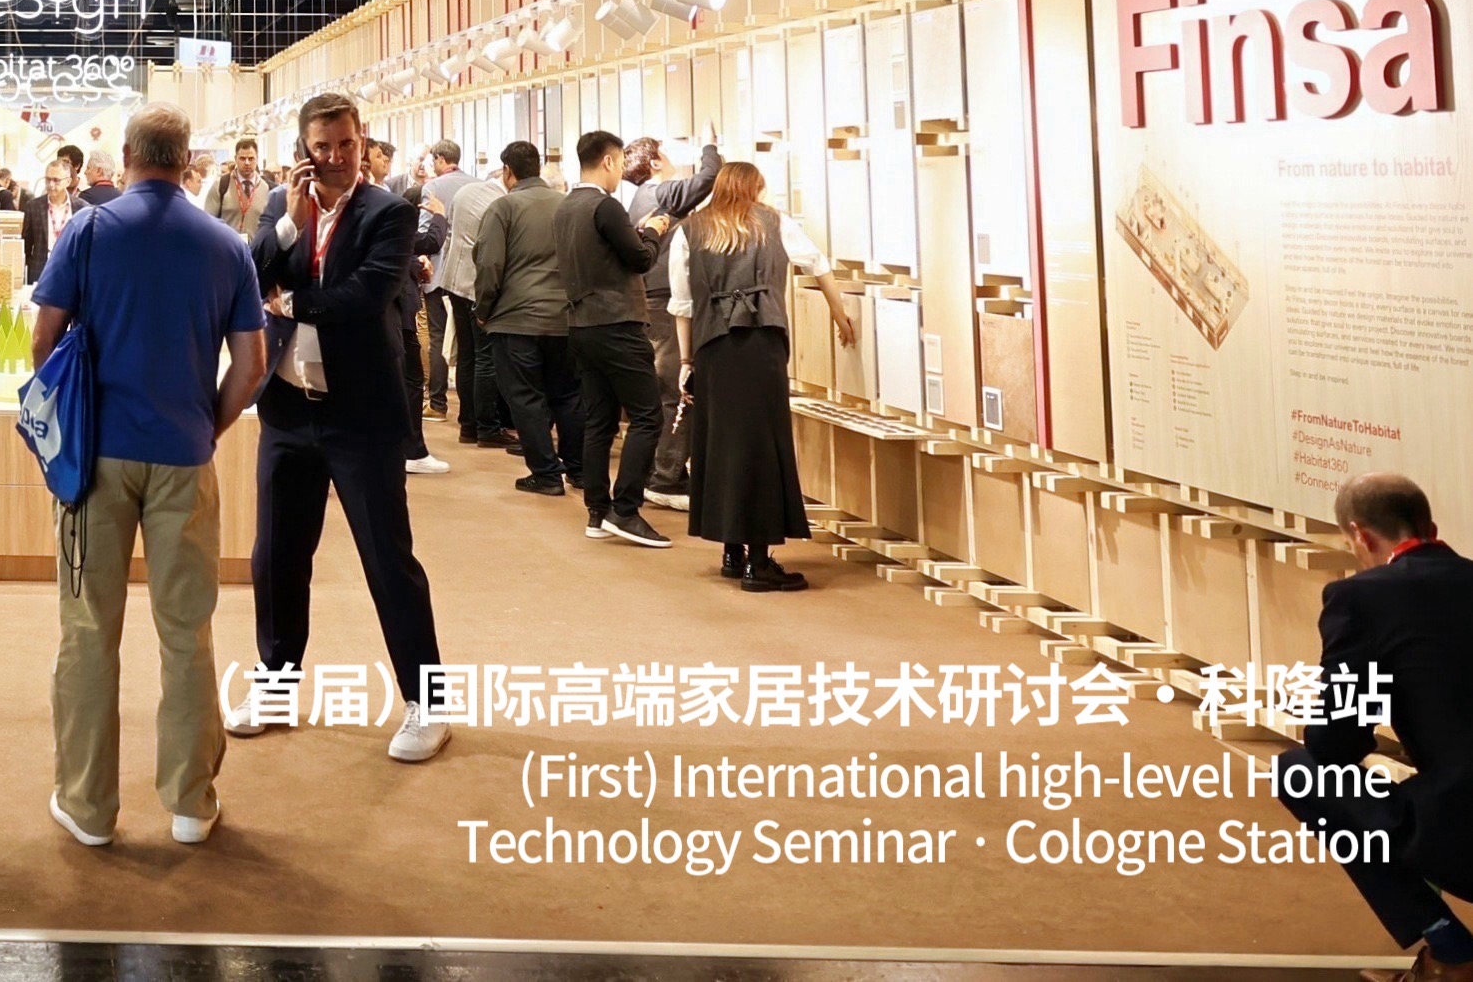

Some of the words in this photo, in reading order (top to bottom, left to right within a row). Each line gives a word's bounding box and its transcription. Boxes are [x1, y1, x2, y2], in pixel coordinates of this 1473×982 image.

[1278, 159, 1316, 178] From
[1319, 159, 1369, 178] nature
[1373, 157, 1389, 177] to
[1291, 409, 1402, 441] #FromNatureToHabitat
[1292, 430, 1372, 456] #DesignAsNature
[1293, 451, 1349, 474] #Habitat360
